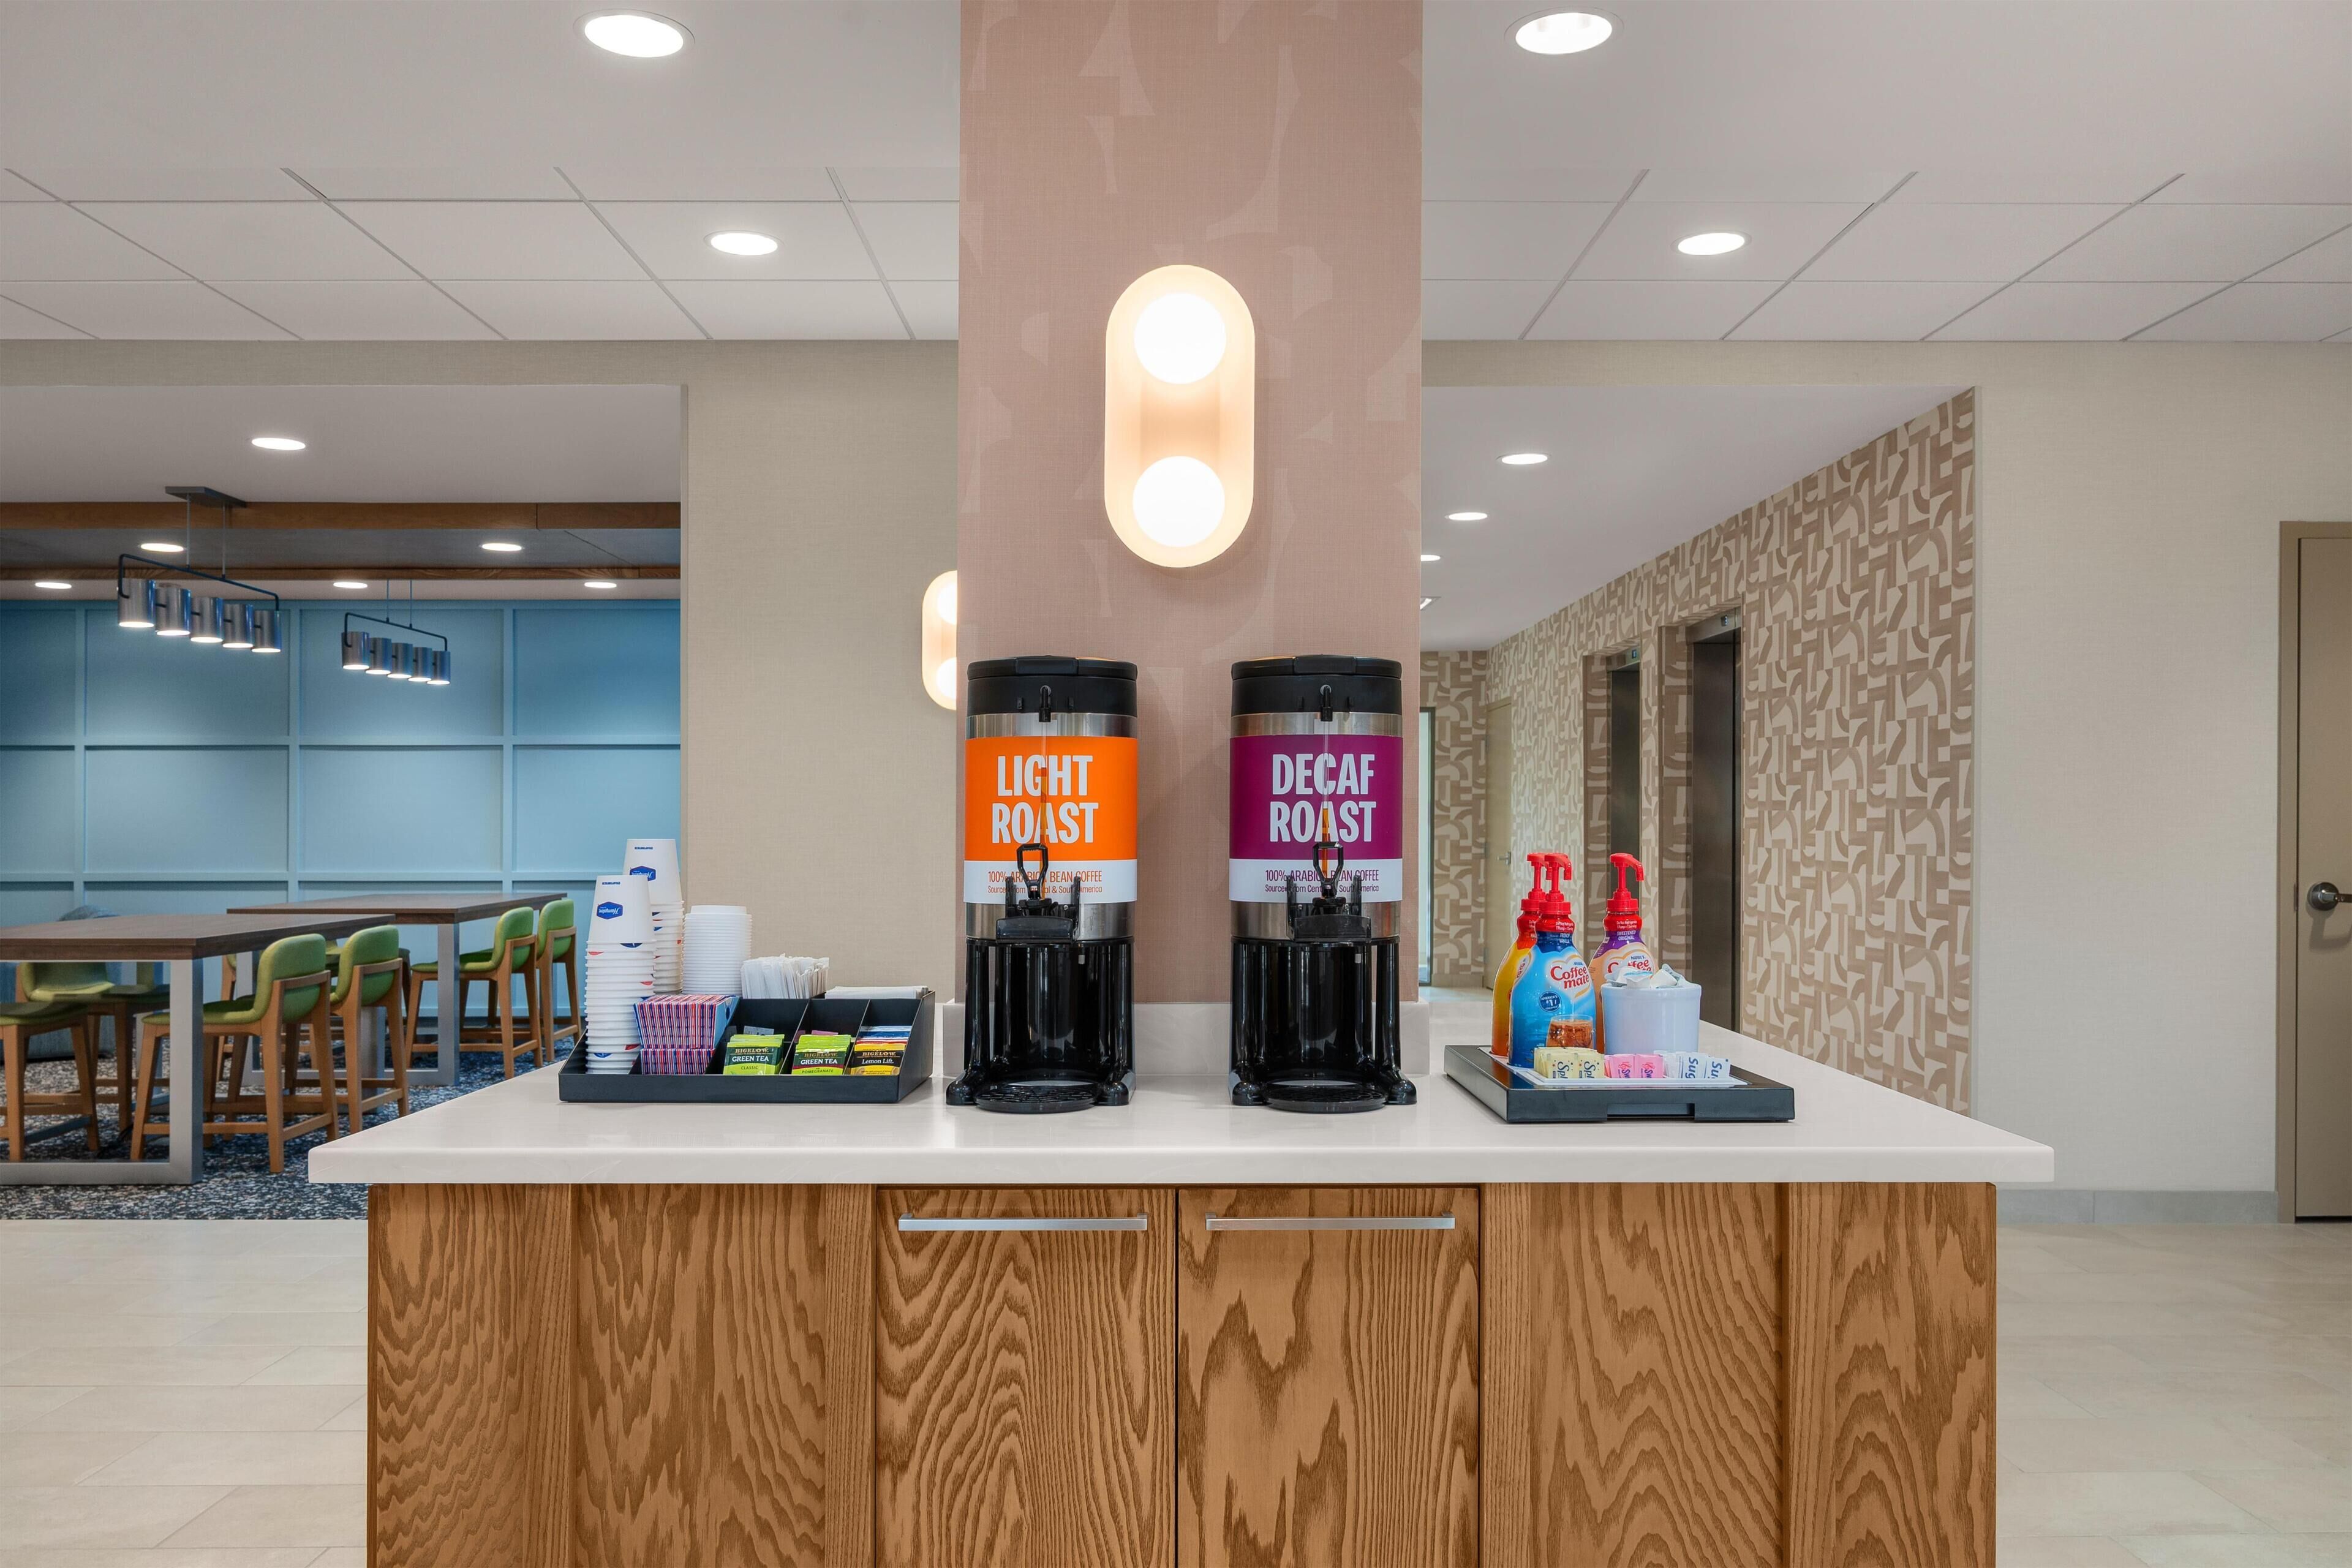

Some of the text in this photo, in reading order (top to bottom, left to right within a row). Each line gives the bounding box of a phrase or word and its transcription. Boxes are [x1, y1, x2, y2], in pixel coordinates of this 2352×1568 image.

[997, 755, 1093, 796] LIGHT
[1272, 753, 1375, 796] DECAF
[992, 801, 1099, 844] ROAST
[1270, 800, 1377, 843] ROAST
[988, 871, 1008, 883] 100%
[1011, 871, 1047, 883] ARBIC
[1050, 871, 1072, 883] BEAN
[1265, 870, 1287, 881] 100%
[1290, 870, 1322, 881] ARABIC
[1331, 870, 1352, 881] BAN
[1550, 966, 1588, 981] Coffee
[1563, 974, 1589, 989] mate
[1708, 1061, 1722, 1078] Su
